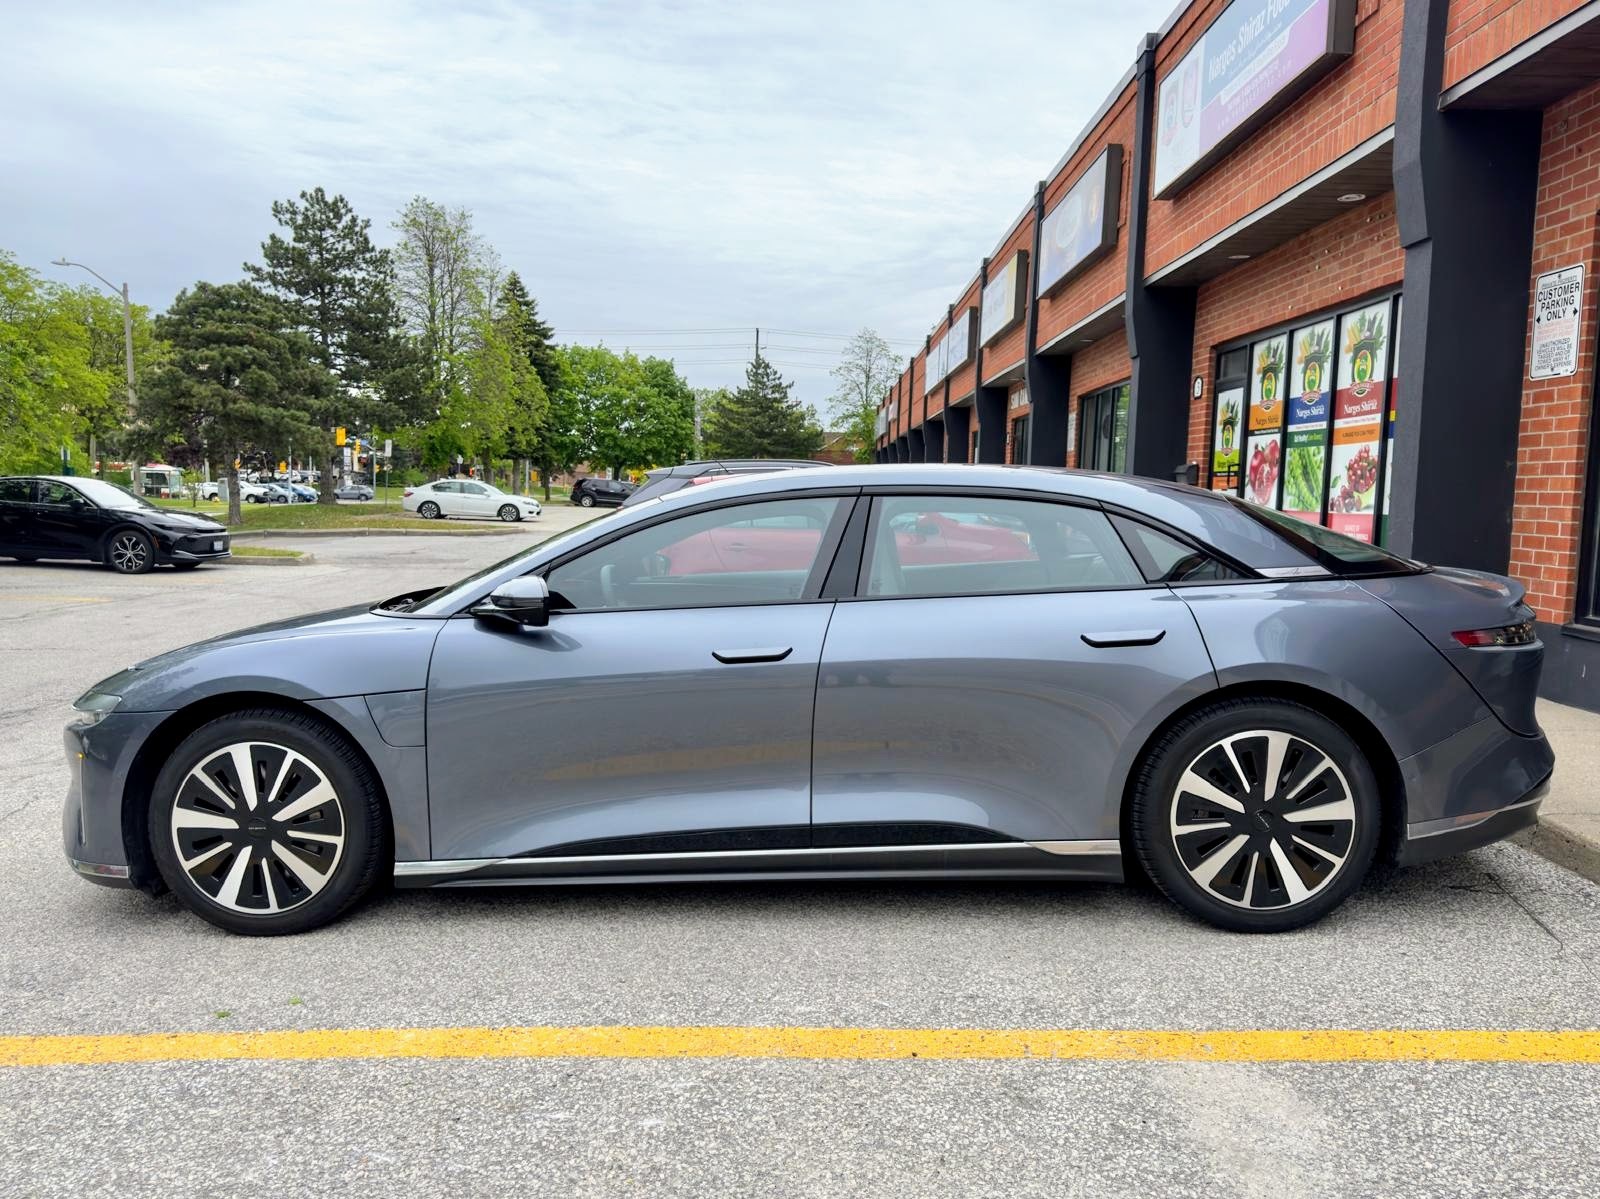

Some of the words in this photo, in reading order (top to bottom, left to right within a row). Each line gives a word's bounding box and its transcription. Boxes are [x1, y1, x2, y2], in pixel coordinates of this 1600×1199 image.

[1208, 39, 1236, 83] Narges
[1238, 9, 1266, 53] Shiraz
[1267, 0, 1290, 24] Foo
[1538, 281, 1580, 302] CUSTOMER
[1541, 295, 1574, 312] PARKING
[1547, 307, 1567, 321] ONLY
[1296, 408, 1311, 419] Narges
[1344, 404, 1361, 416] Narges
